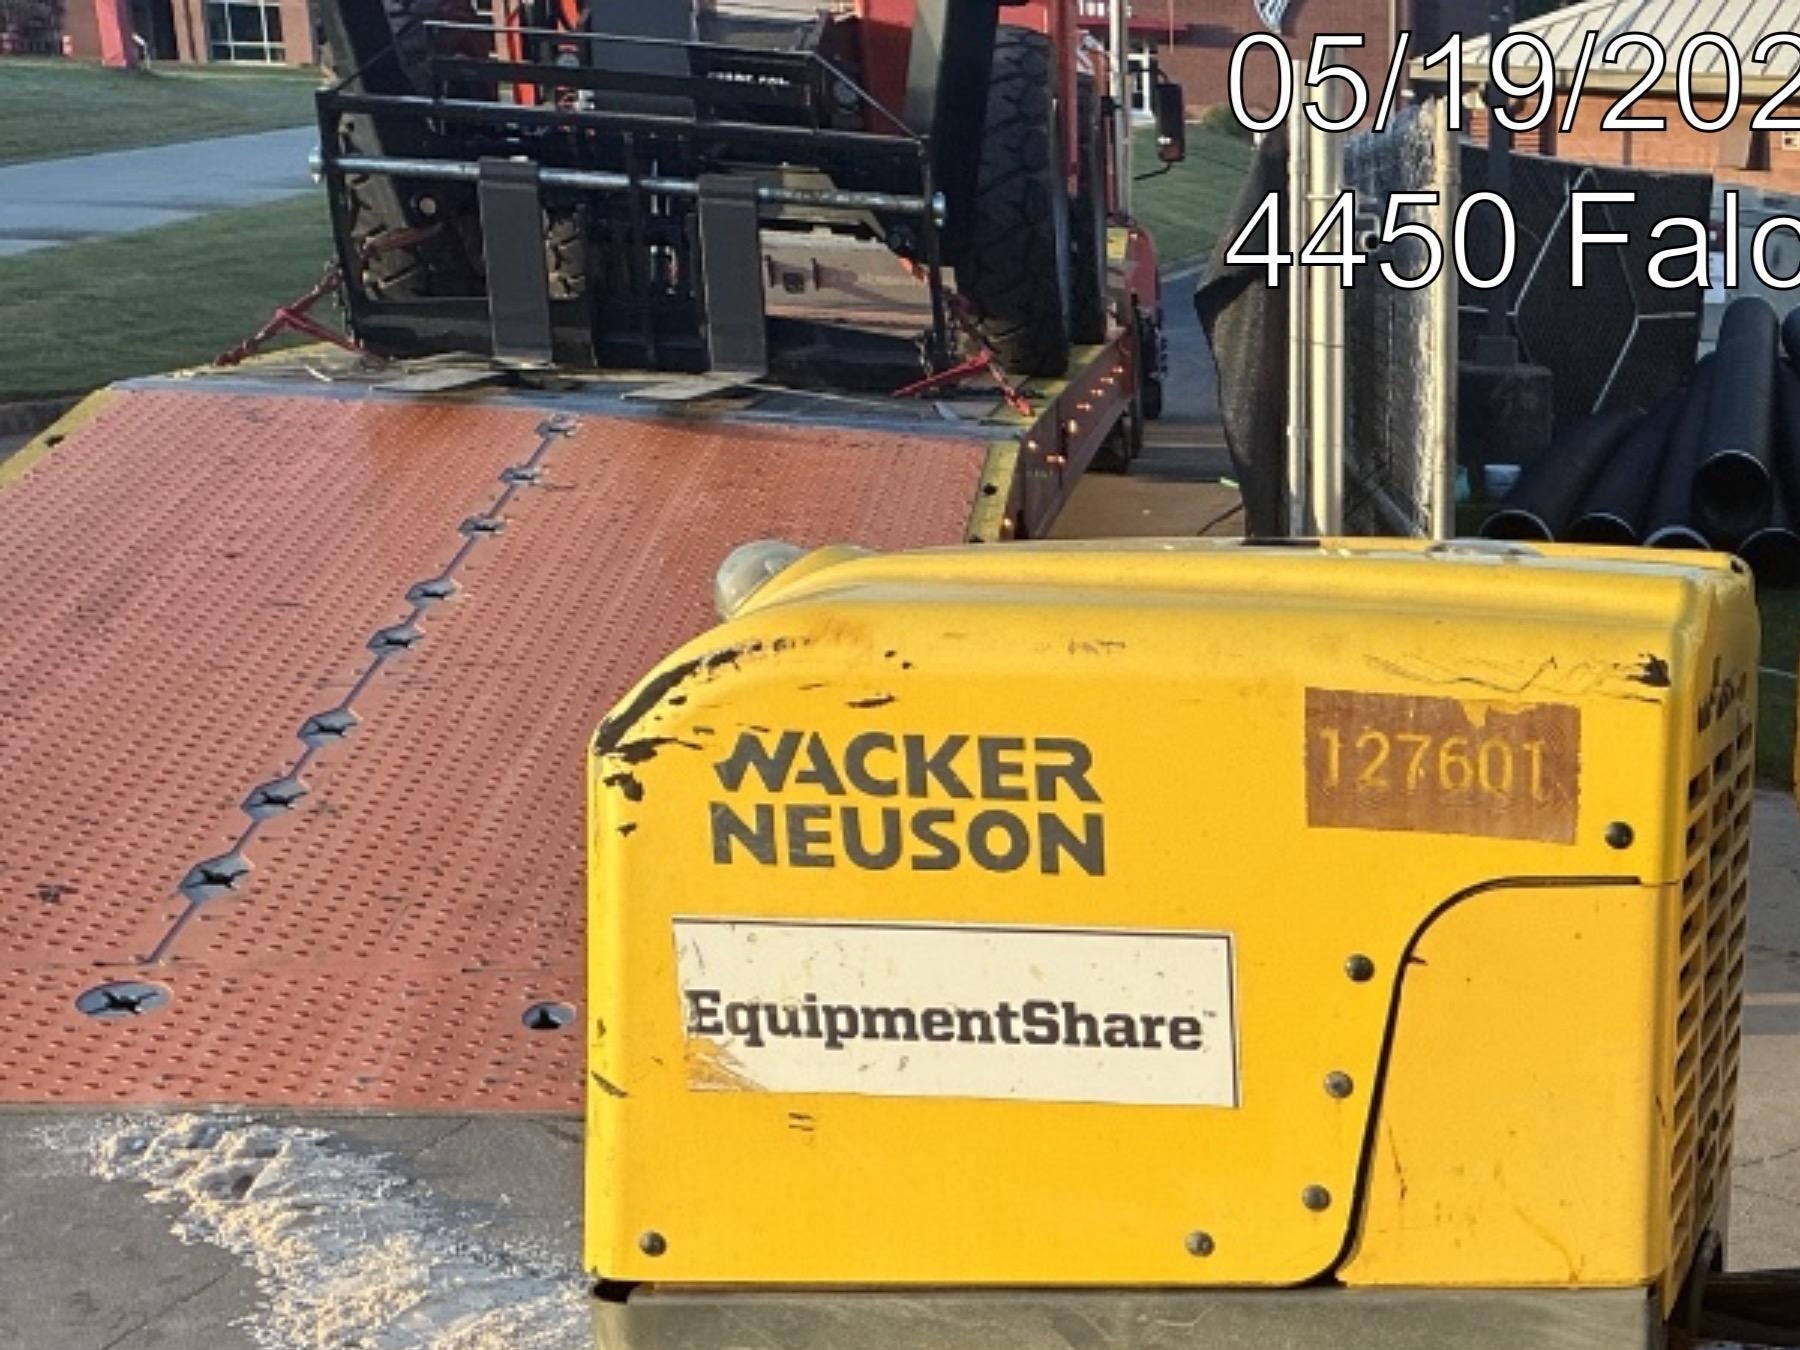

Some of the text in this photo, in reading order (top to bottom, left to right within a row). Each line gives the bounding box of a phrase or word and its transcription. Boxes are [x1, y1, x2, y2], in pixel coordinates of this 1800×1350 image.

[713, 729, 1104, 803] WACKER
[1319, 725, 1548, 803] 127601
[710, 802, 1106, 876] NEUSON
